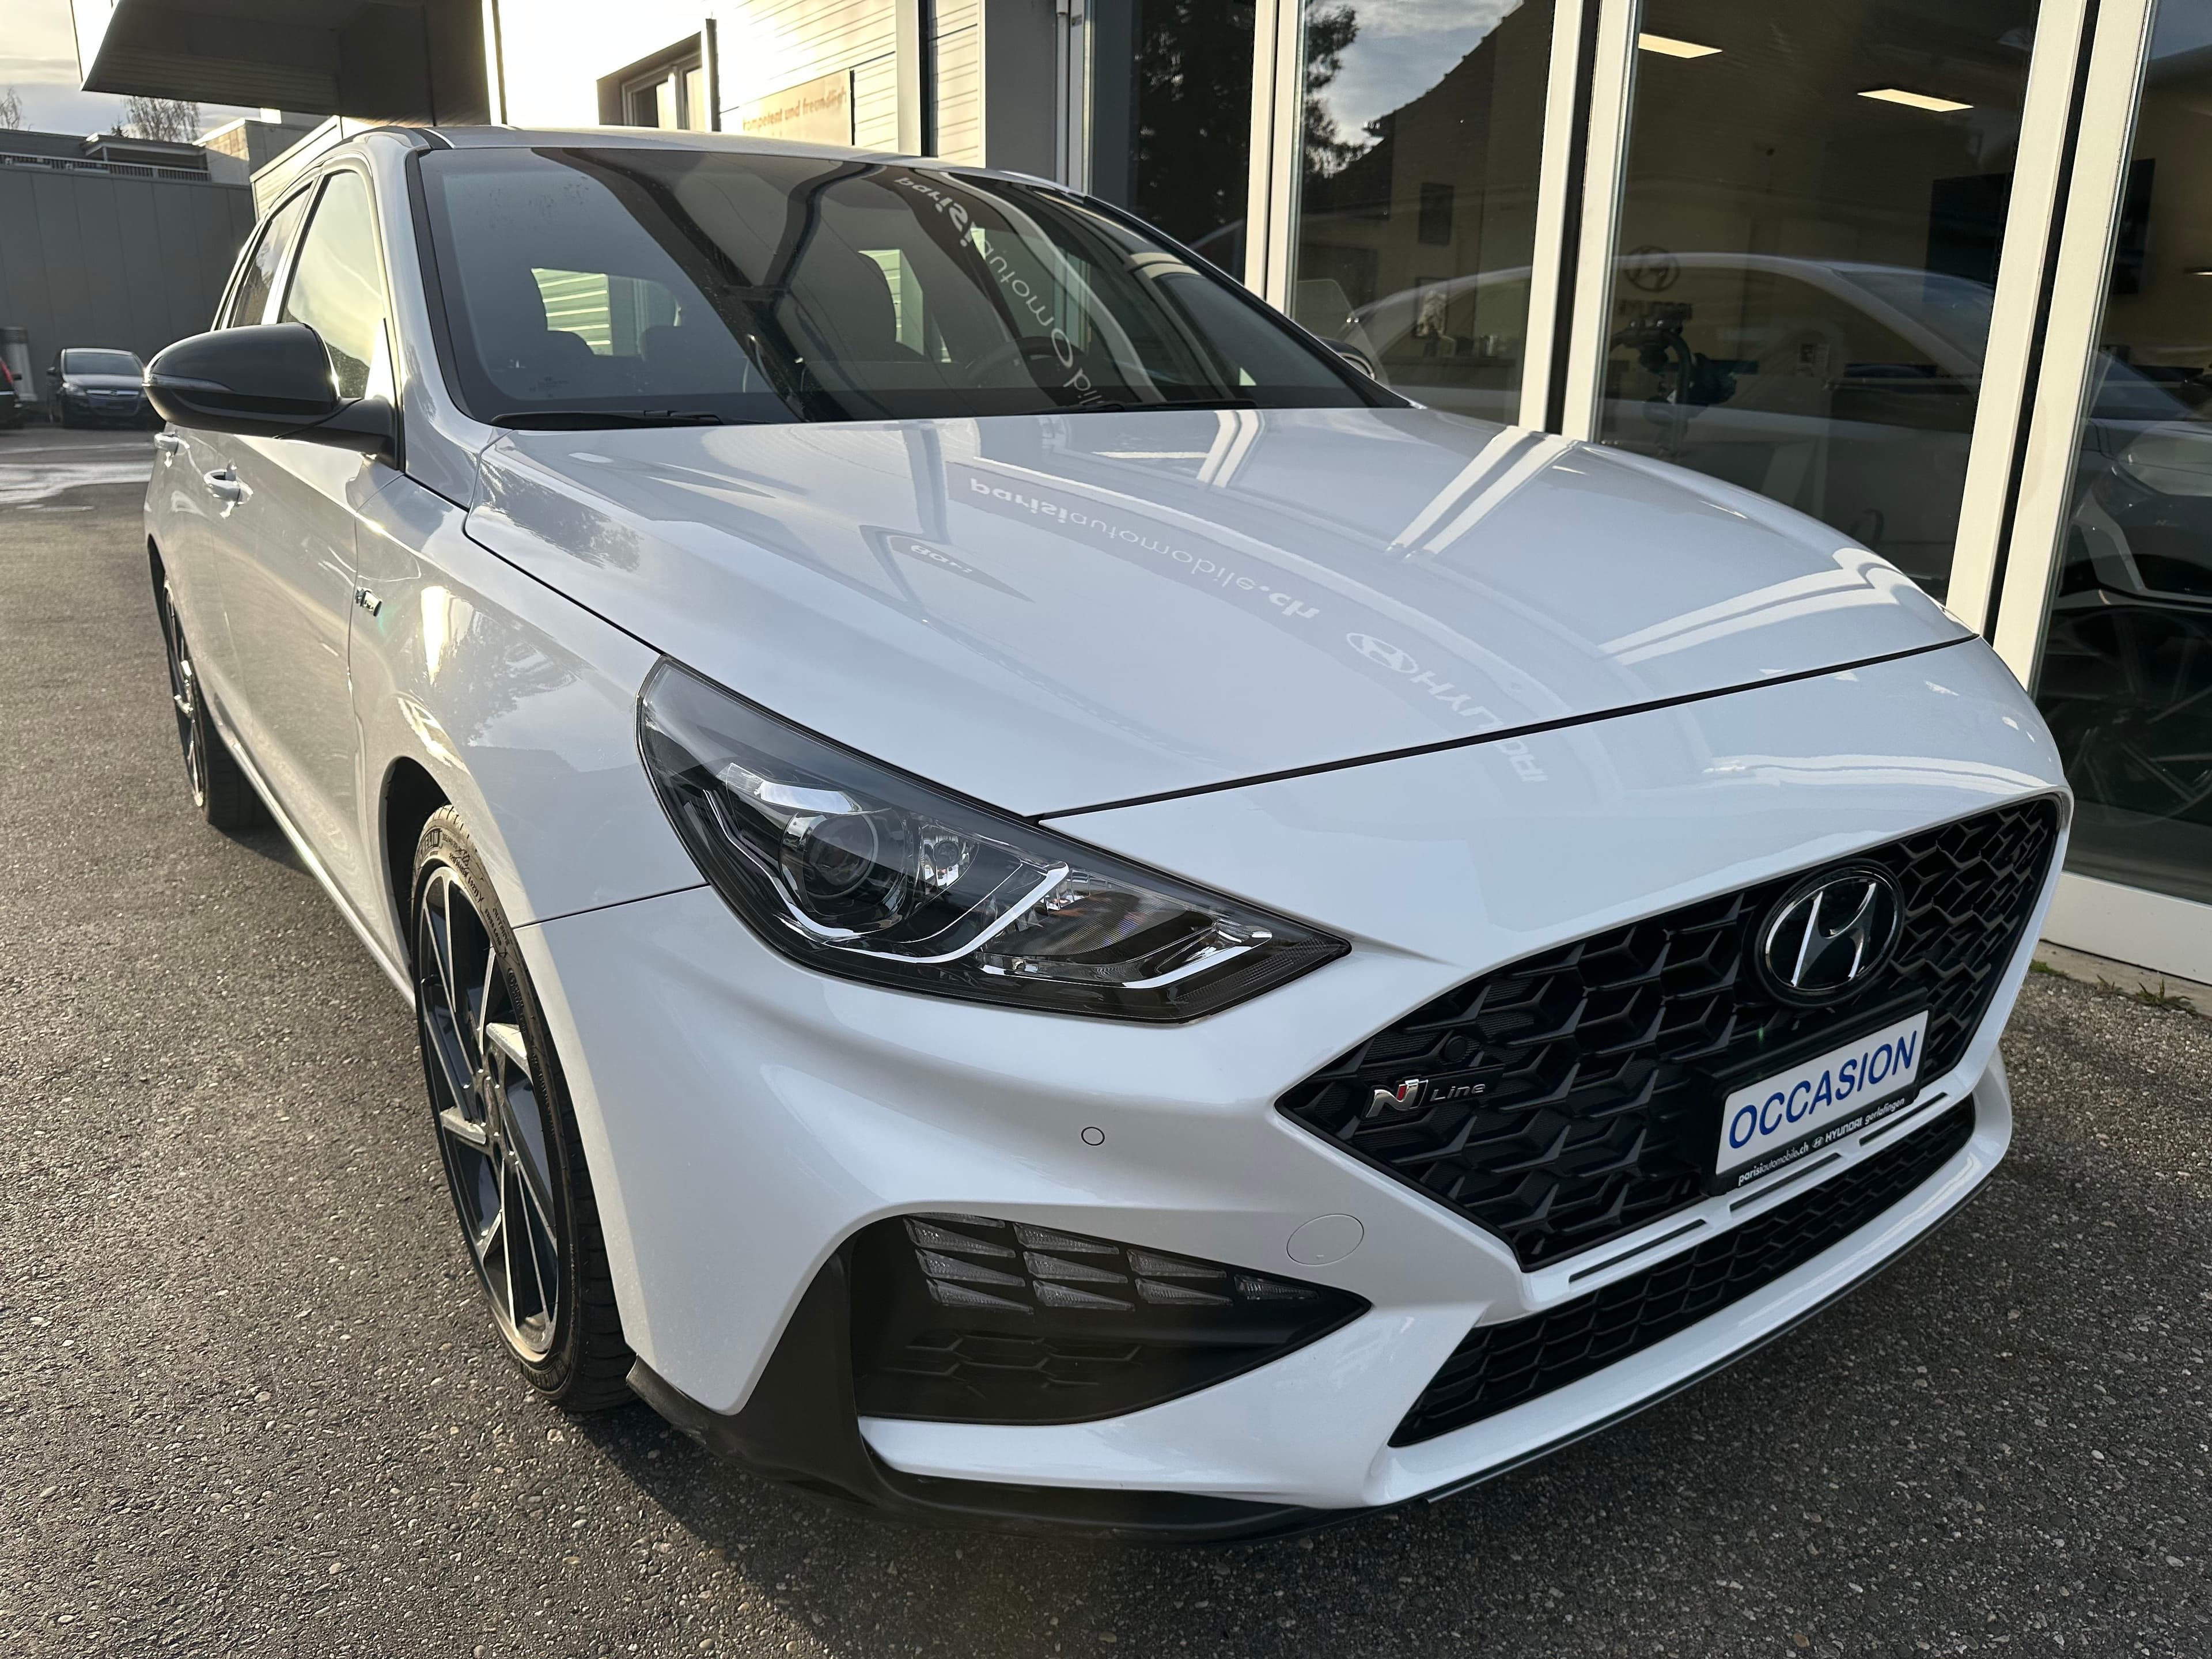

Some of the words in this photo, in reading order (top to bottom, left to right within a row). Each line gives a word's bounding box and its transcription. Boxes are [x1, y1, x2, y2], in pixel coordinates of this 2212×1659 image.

[785, 100, 800, 120] und
[1431, 1083, 1486, 1102] Line
[1729, 1031, 1917, 1149] OCCASION
[1738, 1142, 1809, 1187] parisiautomobile.ch
[1825, 1119, 1863, 1143] HYUNDAI
[1864, 1098, 1905, 1126] gerlafingen
